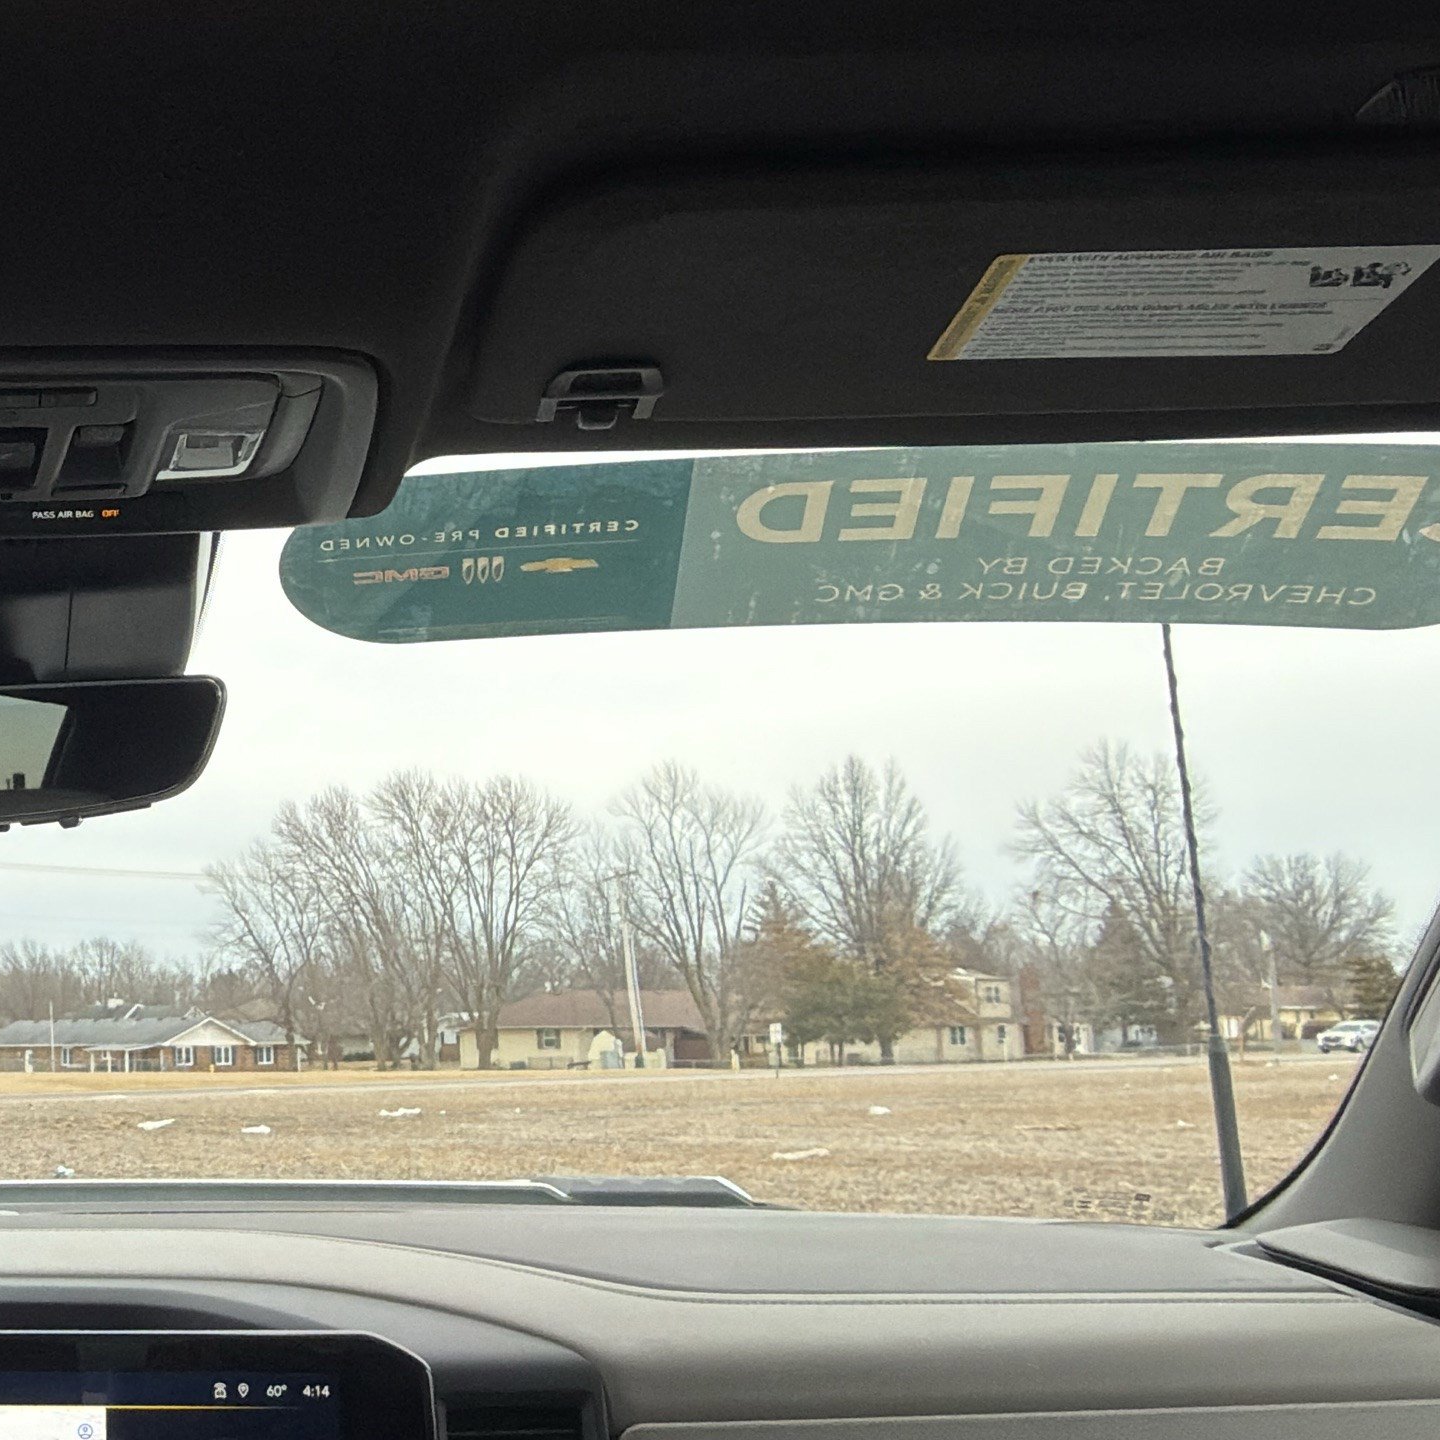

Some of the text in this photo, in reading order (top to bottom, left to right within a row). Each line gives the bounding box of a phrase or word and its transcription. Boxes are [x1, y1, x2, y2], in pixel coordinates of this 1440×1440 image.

[31, 509, 120, 520] PASS AIR BAG OFF
[302, 1384, 330, 1398] 4:14
